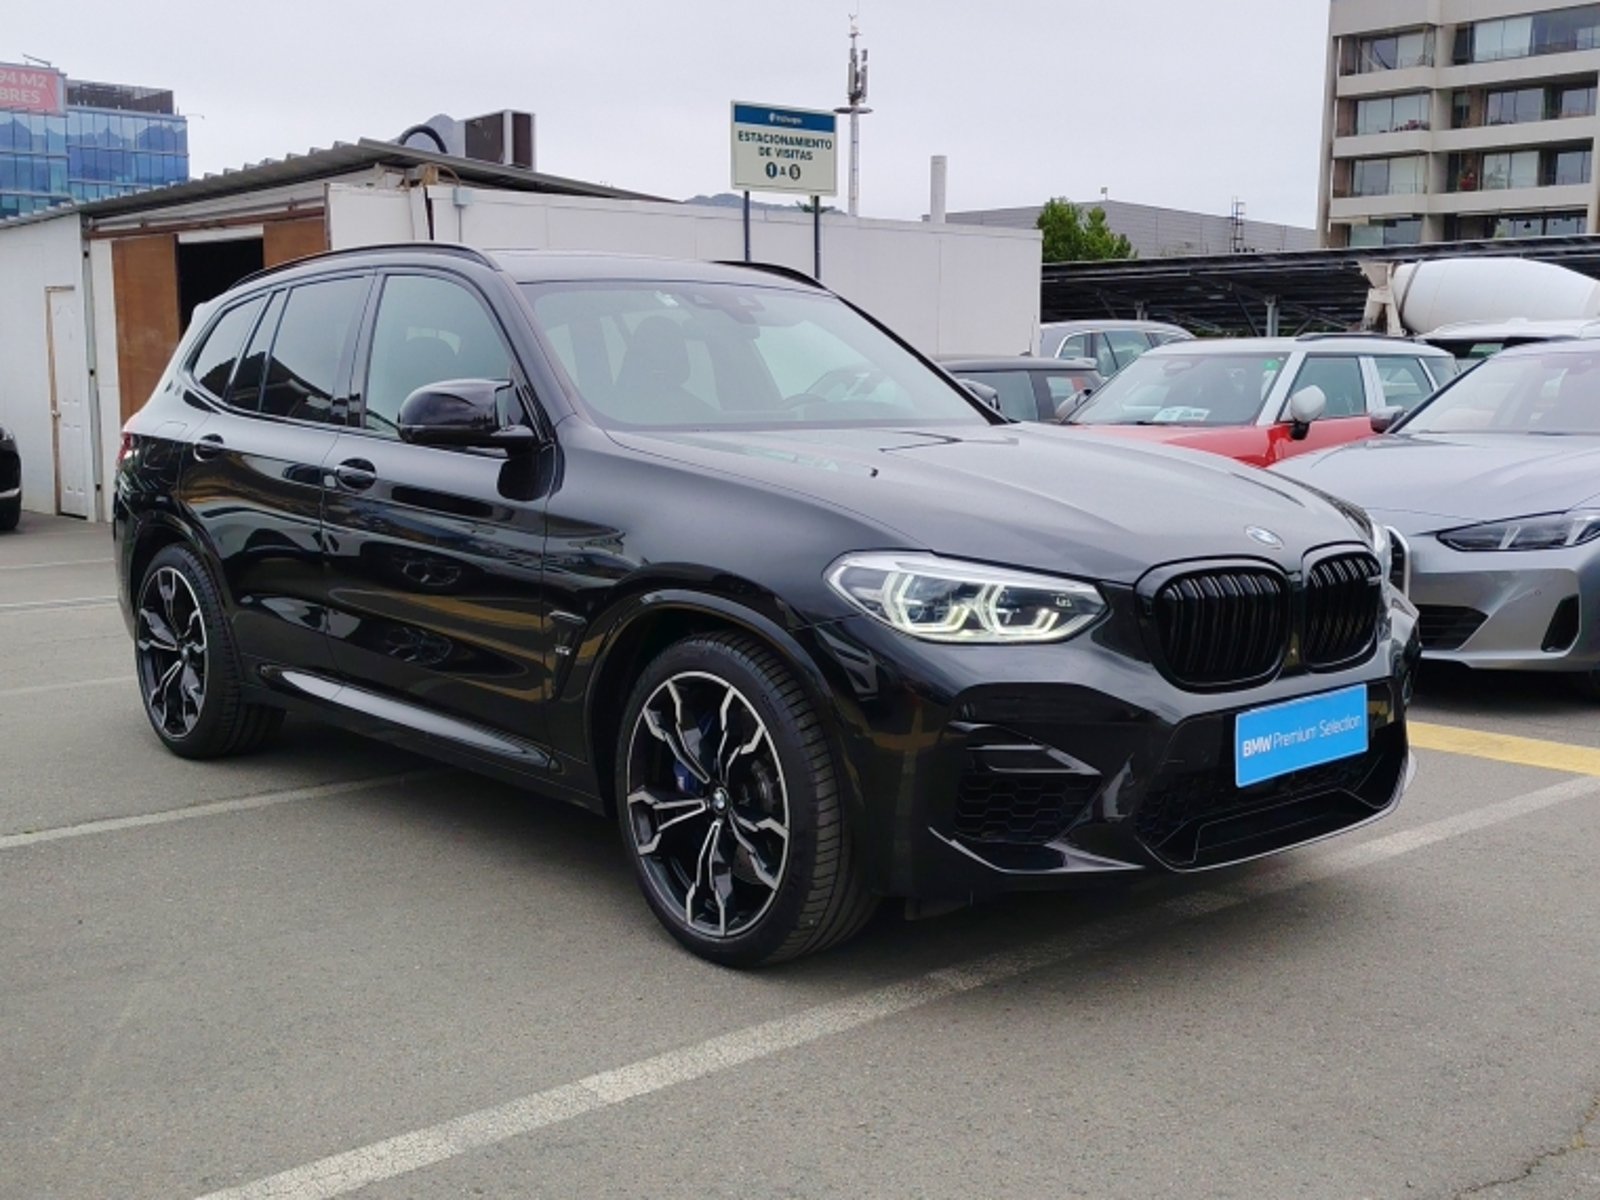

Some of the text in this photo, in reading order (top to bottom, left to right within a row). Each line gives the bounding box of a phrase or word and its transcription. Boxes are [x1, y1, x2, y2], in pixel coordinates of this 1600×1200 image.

[20, 73, 48, 89] M2
[738, 130, 833, 150] ESTACIONAMIENTO
[759, 146, 813, 161] DE VISITAS
[1243, 714, 1361, 758] BMW Premium Selection
